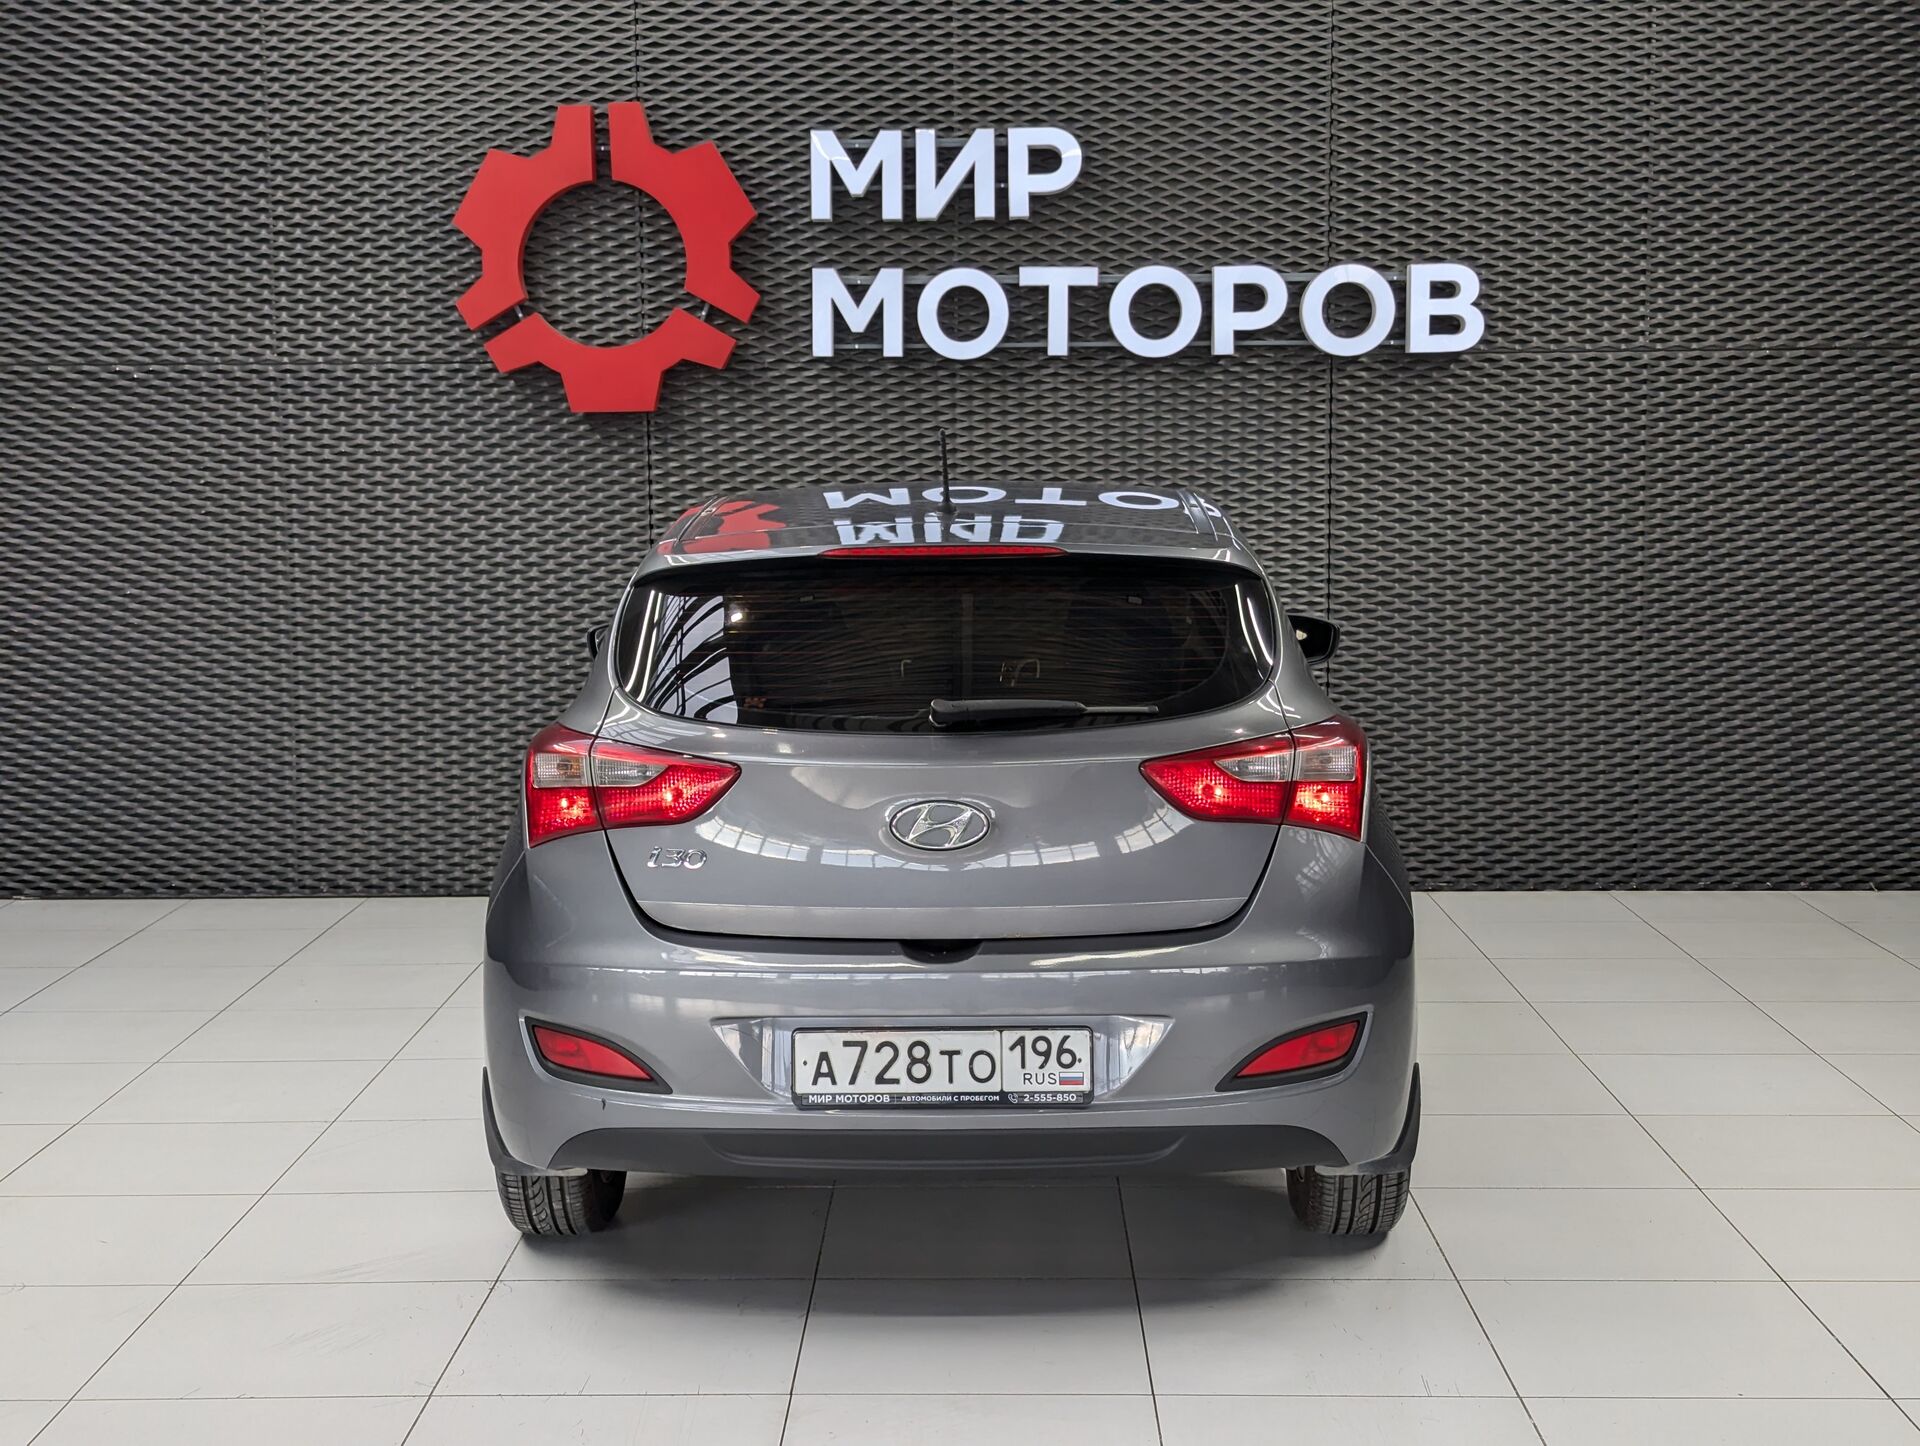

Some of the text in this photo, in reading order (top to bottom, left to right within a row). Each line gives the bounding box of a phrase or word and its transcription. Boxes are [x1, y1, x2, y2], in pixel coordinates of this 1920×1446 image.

[810, 127, 1083, 222] МИР
[811, 263, 1486, 361] МОТОРОВ
[647, 846, 707, 870] i30
[811, 1040, 996, 1086] А728ТО
[1009, 1035, 1077, 1070] 196
[1023, 1072, 1057, 1086] RUS
[808, 1094, 832, 1104] МИР
[835, 1094, 890, 1104] МОТОРОВ
[901, 1095, 952, 1103] АВТОМОБИЛИ
[1023, 1093, 1077, 1102] 2-555-850
